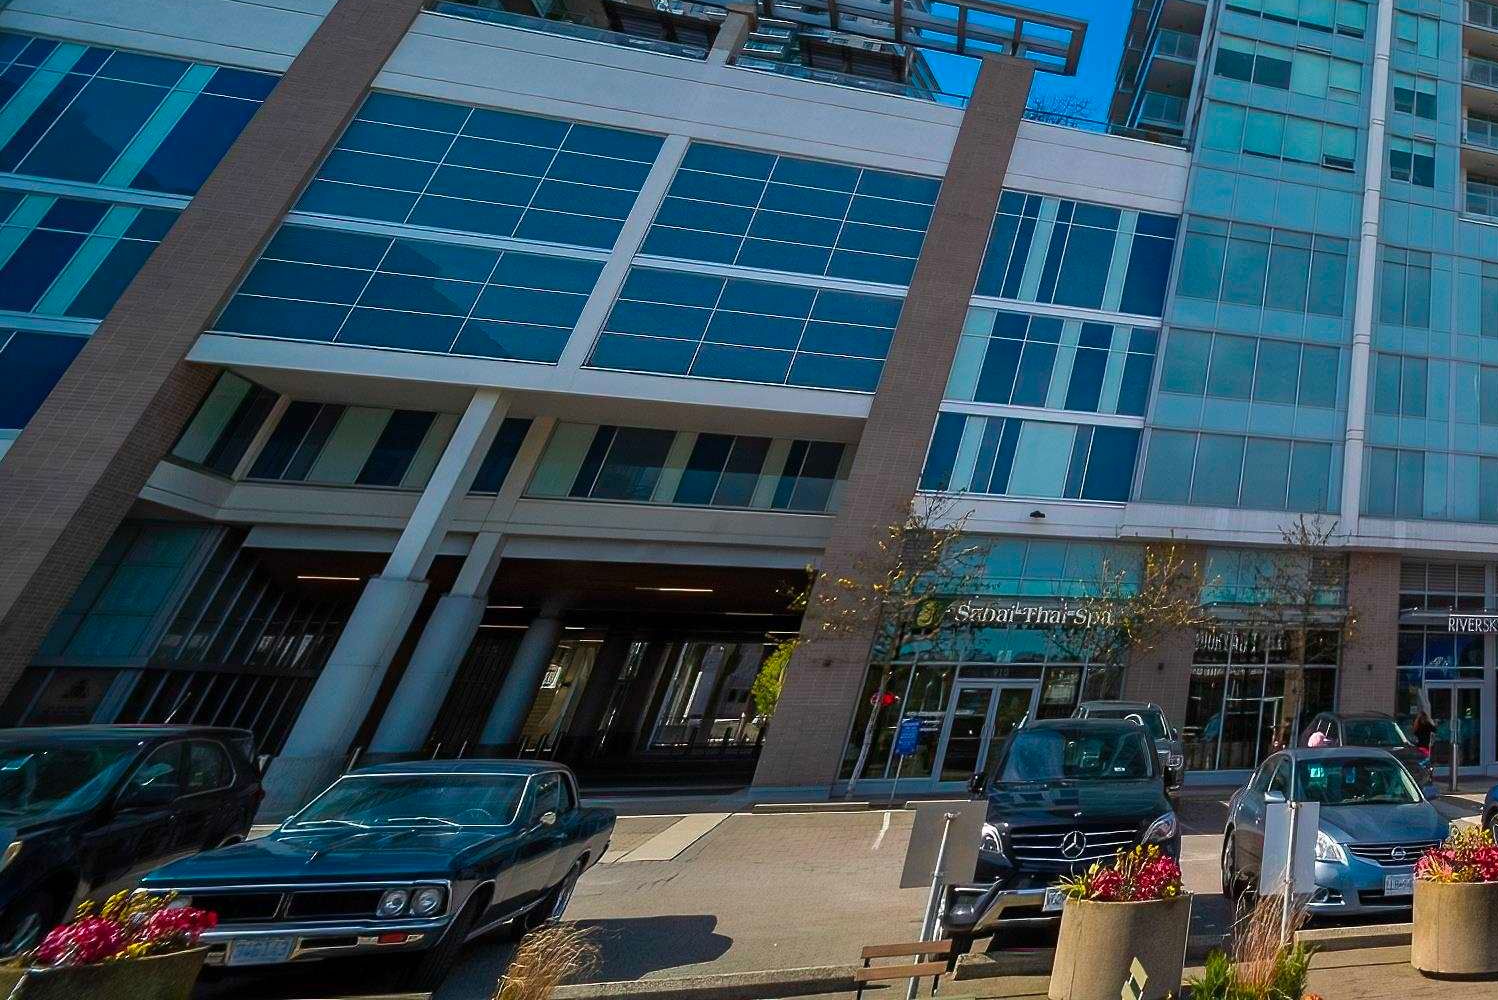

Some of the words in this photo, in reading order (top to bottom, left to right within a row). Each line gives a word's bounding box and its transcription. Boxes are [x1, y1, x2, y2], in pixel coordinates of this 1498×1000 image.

[954, 602, 1014, 622] Sabai
[1023, 605, 1067, 624] Thai
[1073, 608, 1113, 628] Spa
